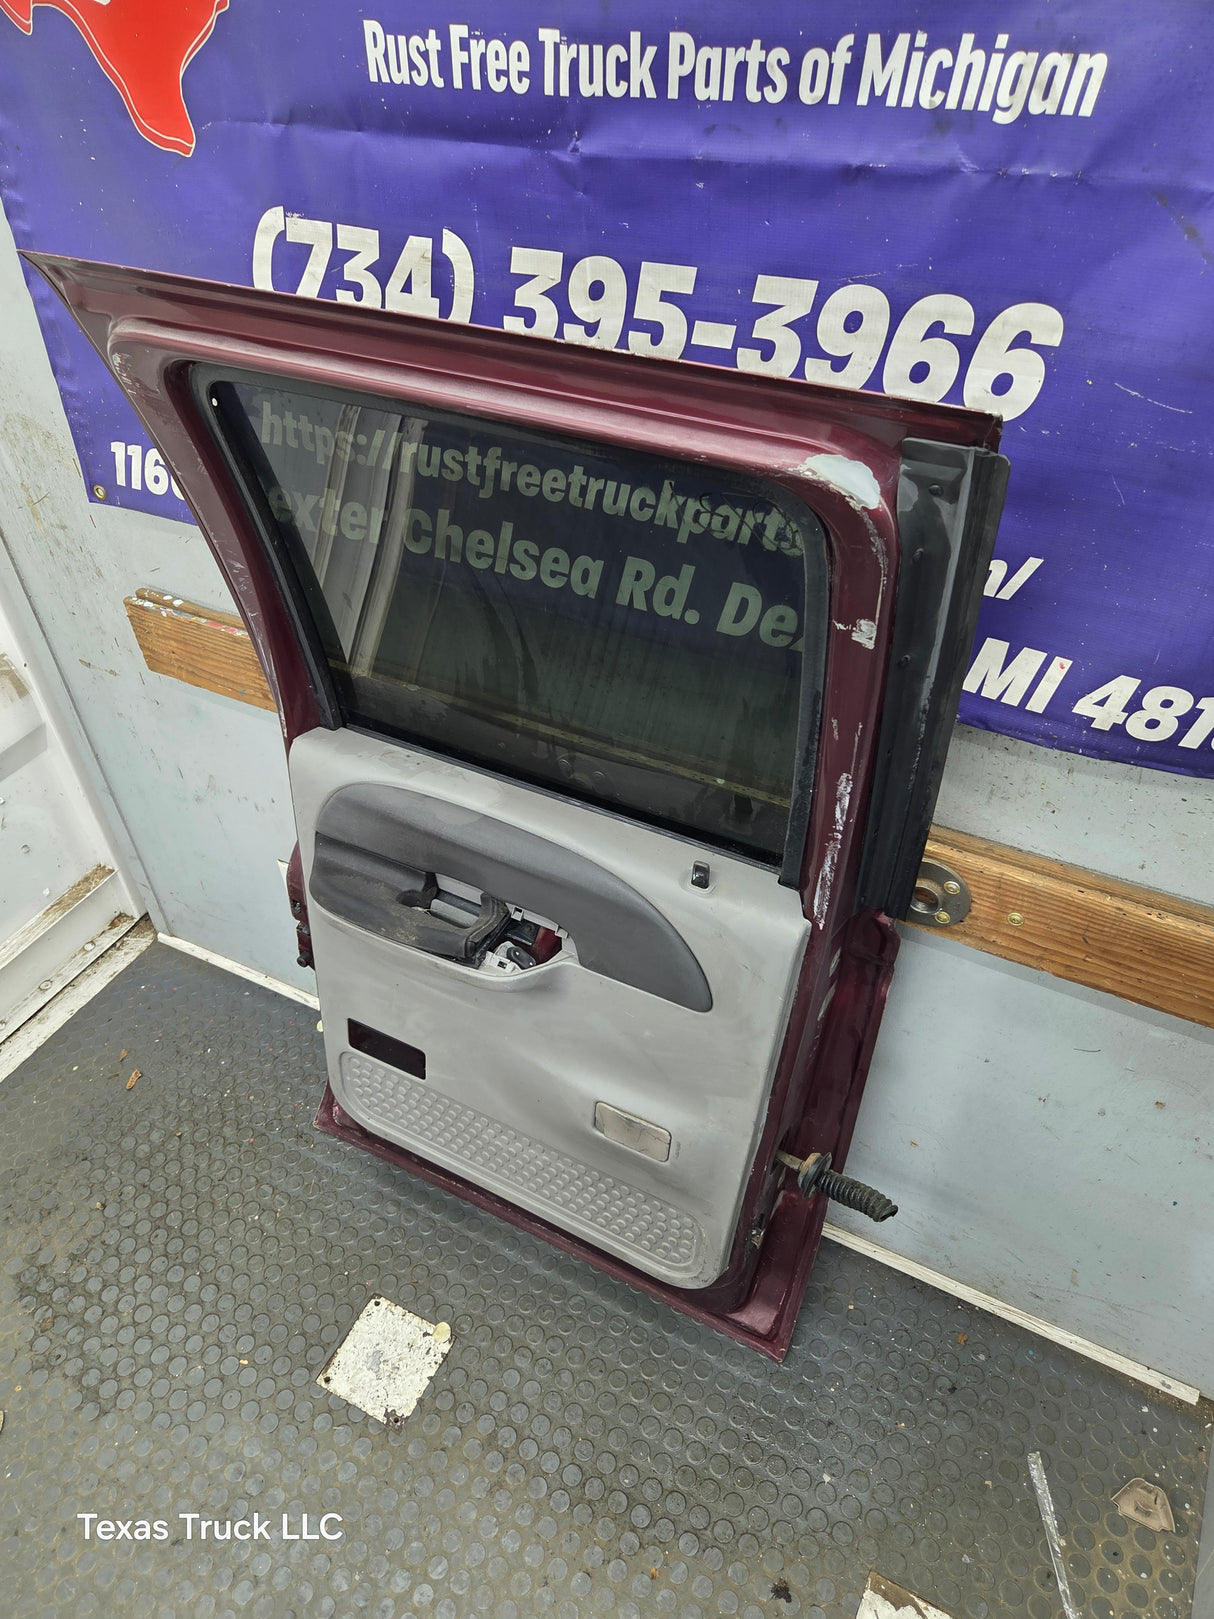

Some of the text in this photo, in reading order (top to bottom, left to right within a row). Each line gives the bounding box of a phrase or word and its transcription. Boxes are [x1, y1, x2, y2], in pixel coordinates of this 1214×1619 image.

[364, 20, 1108, 125] Rust Free Truck Parts of Michigan
[252, 206, 1065, 422] (734) 395-3966
[403, 508, 604, 599] Chelsea
[615, 555, 700, 625] Rd.
[716, 581, 806, 652] De
[962, 637, 1074, 714] MI
[1071, 674, 1214, 750] 481
